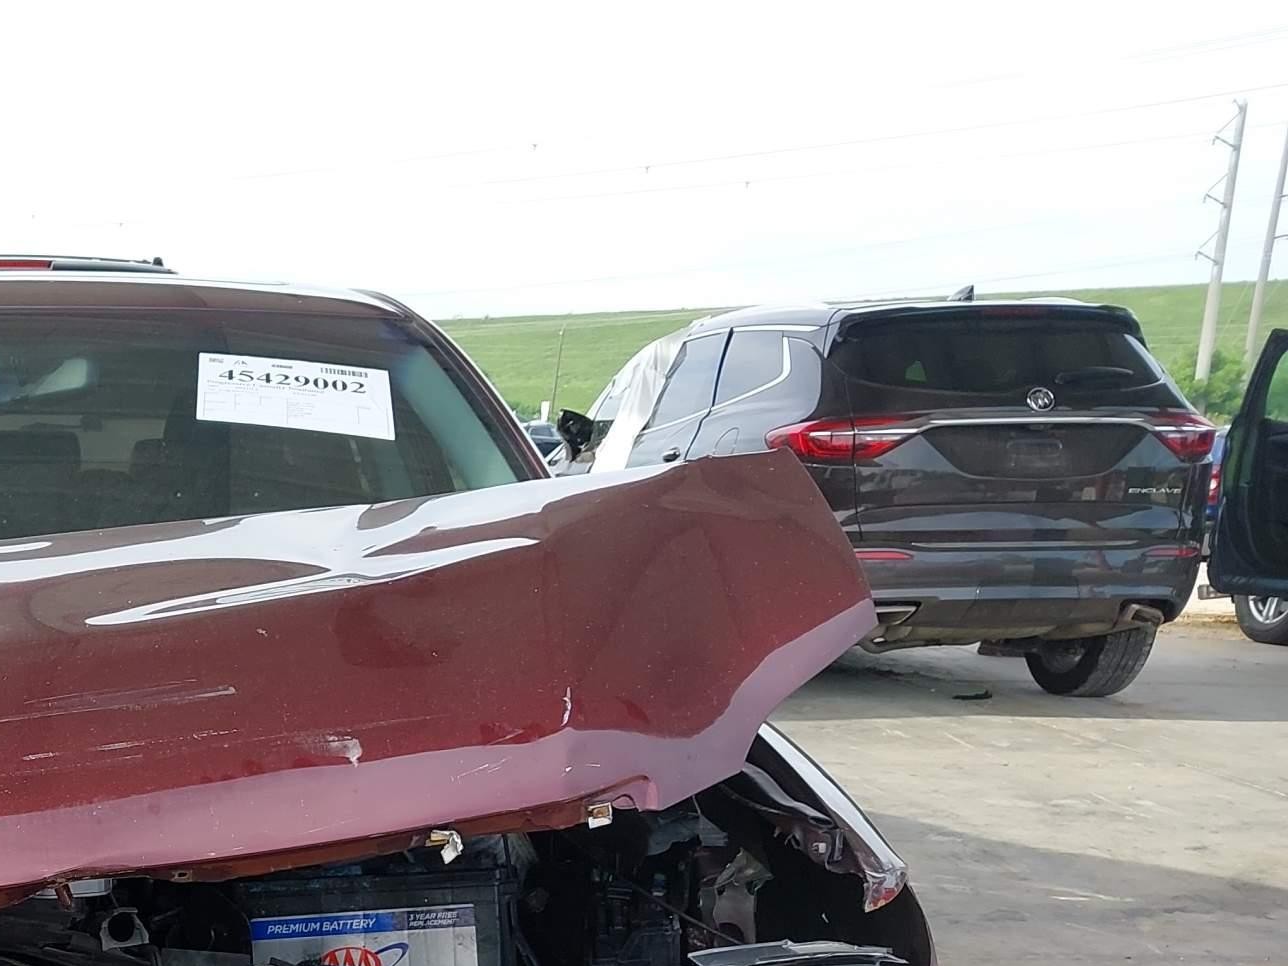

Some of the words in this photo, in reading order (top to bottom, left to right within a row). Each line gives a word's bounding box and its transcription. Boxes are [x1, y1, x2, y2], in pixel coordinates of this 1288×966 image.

[218, 369, 367, 394] 45429002
[415, 912, 437, 921] YEAR
[266, 921, 321, 935] PREMIUM
[322, 918, 376, 932] BATTERY
